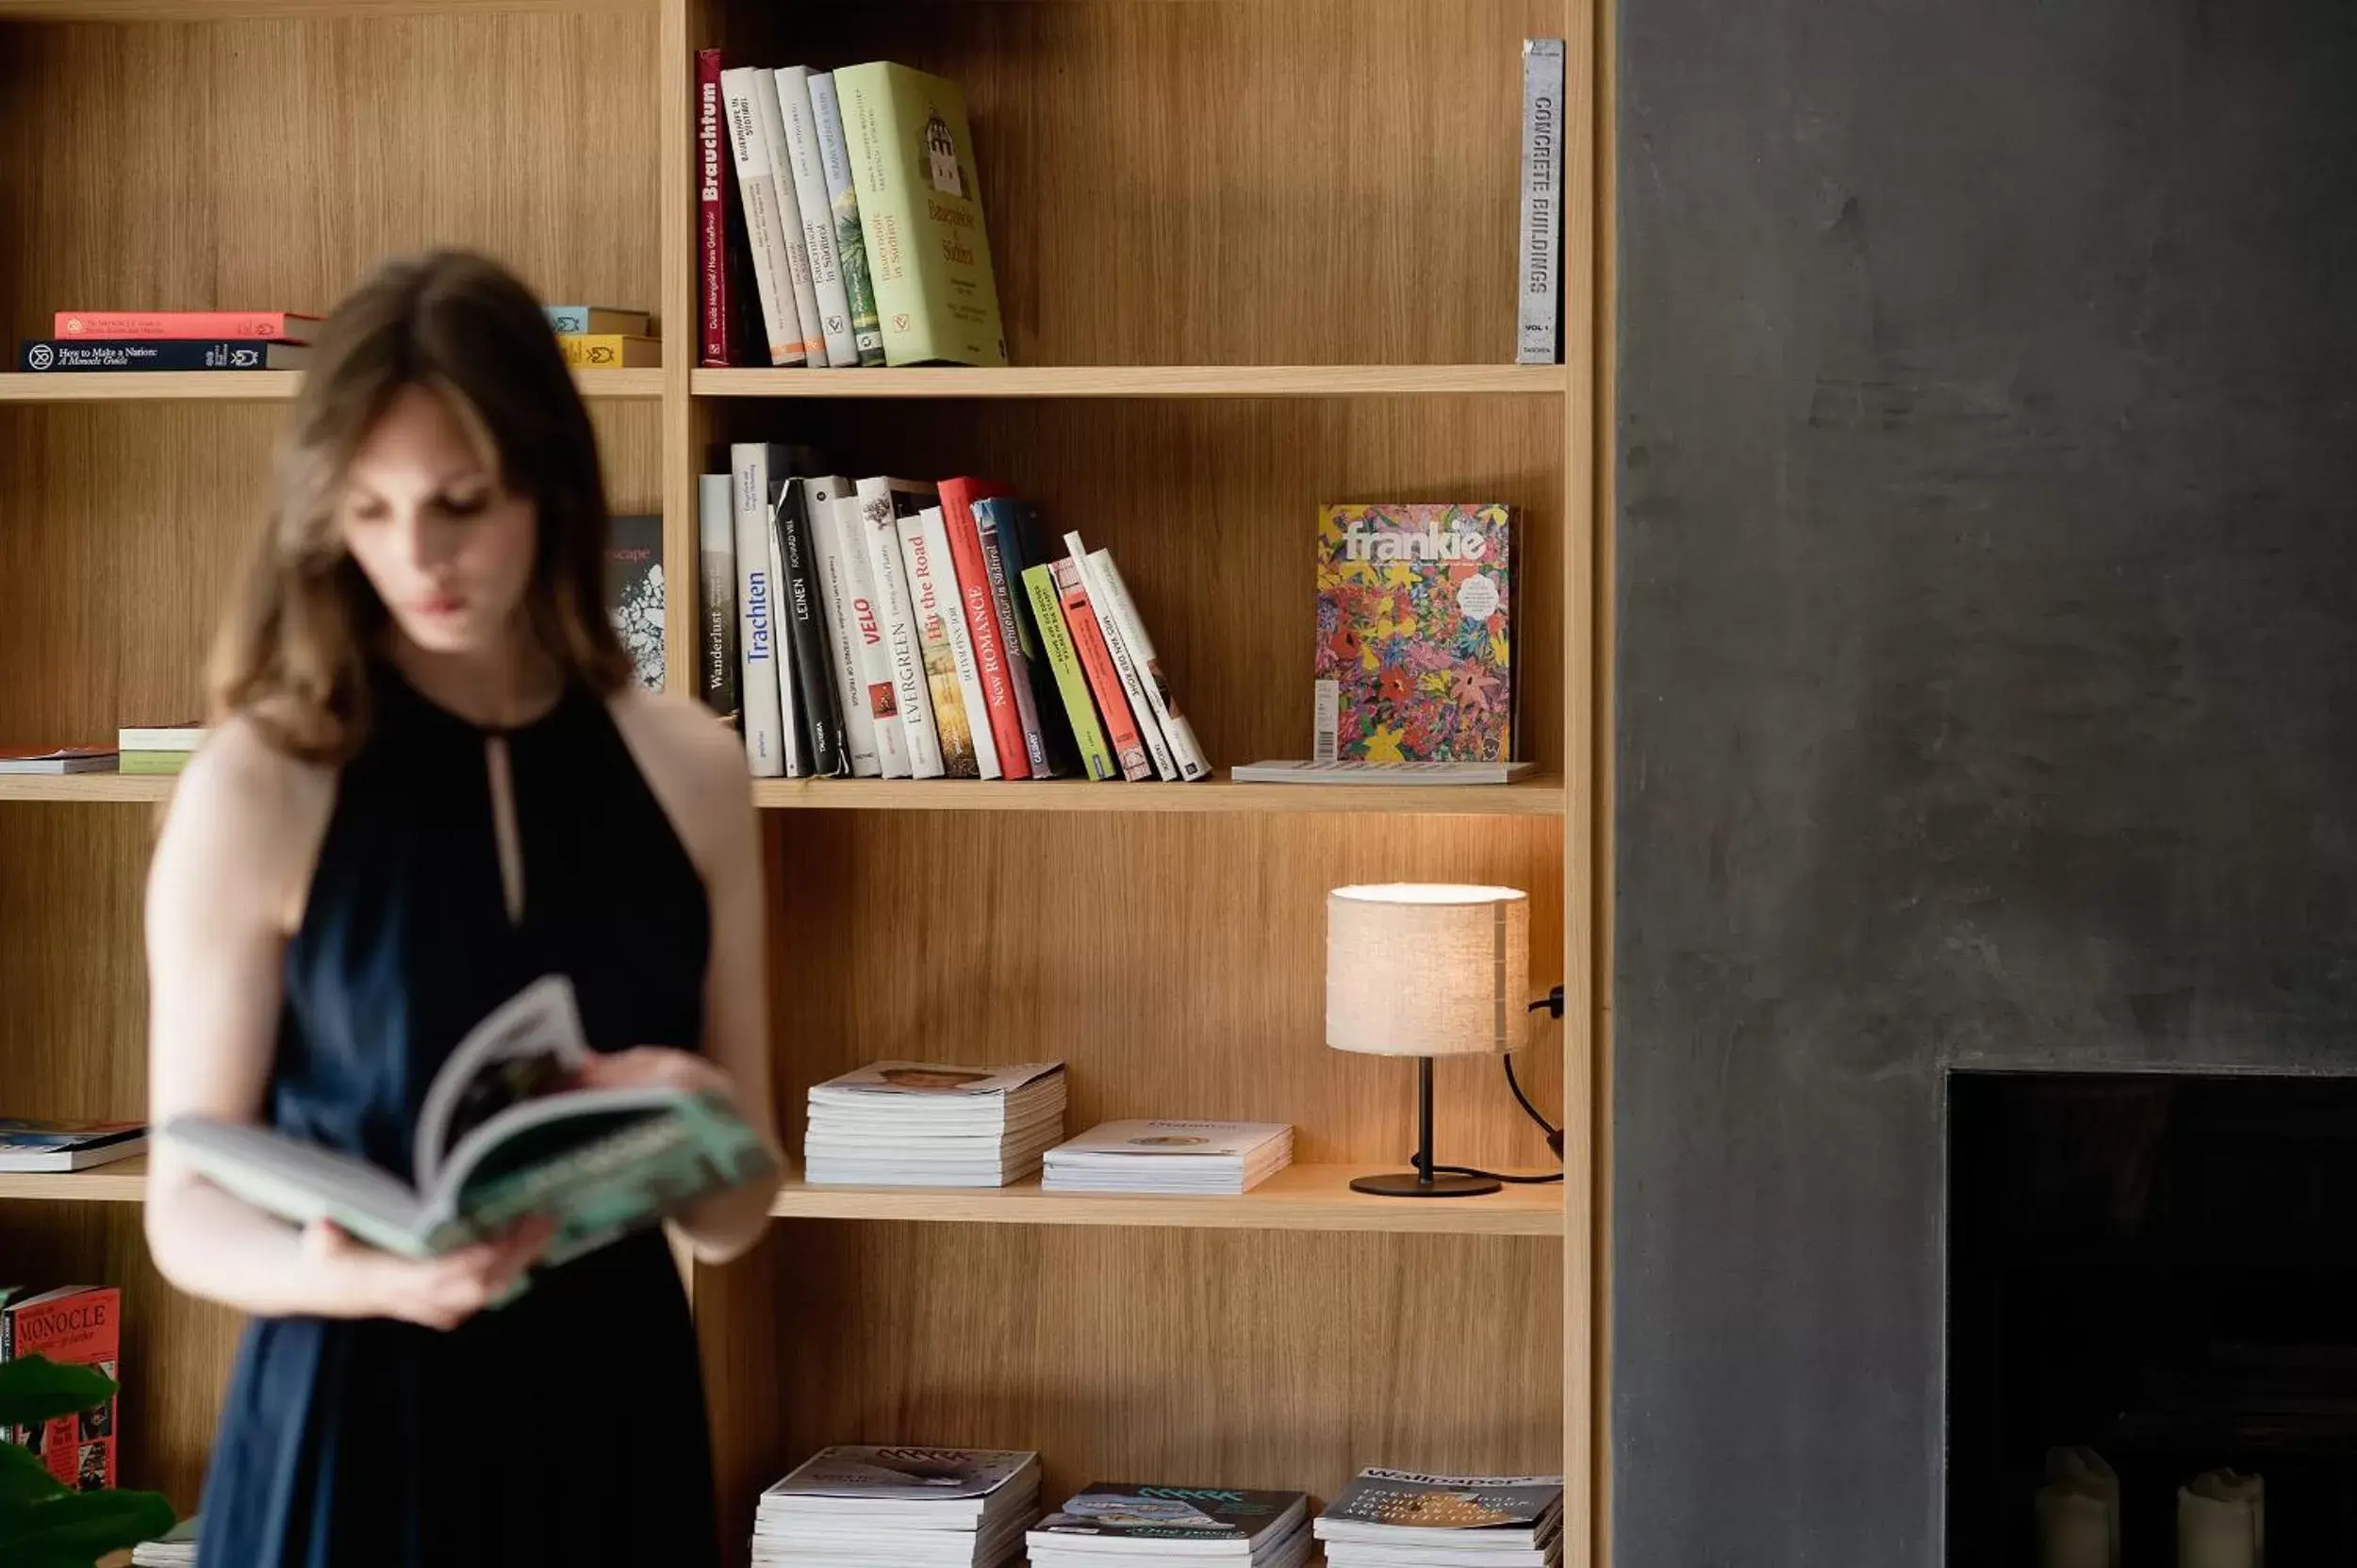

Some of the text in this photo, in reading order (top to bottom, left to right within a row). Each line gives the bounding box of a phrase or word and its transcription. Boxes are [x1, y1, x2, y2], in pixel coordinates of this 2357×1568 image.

[701, 82, 717, 201] Brauchtum
[1528, 96, 1552, 294] CONCRETE BUILDINGS
[58, 348, 79, 357] How
[81, 349, 90, 357] to
[92, 348, 117, 357] Make
[1343, 520, 1486, 560] frankie
[746, 571, 768, 663] Trachten
[793, 577, 809, 620] LEINEN
[853, 597, 882, 647] VELO
[908, 535, 943, 641] Hit the Road
[985, 543, 1020, 657] Architektur in Südtirol
[710, 611, 722, 688] Wanderlust
[892, 621, 922, 724] EVERGREEN
[968, 584, 1006, 707] New ROMANCE
[1110, 636, 1123, 654] VAN
[1117, 653, 1129, 672] DER
[20, 1305, 106, 1342] MONOCLE
[1137, 1487, 1244, 1501] MARK
